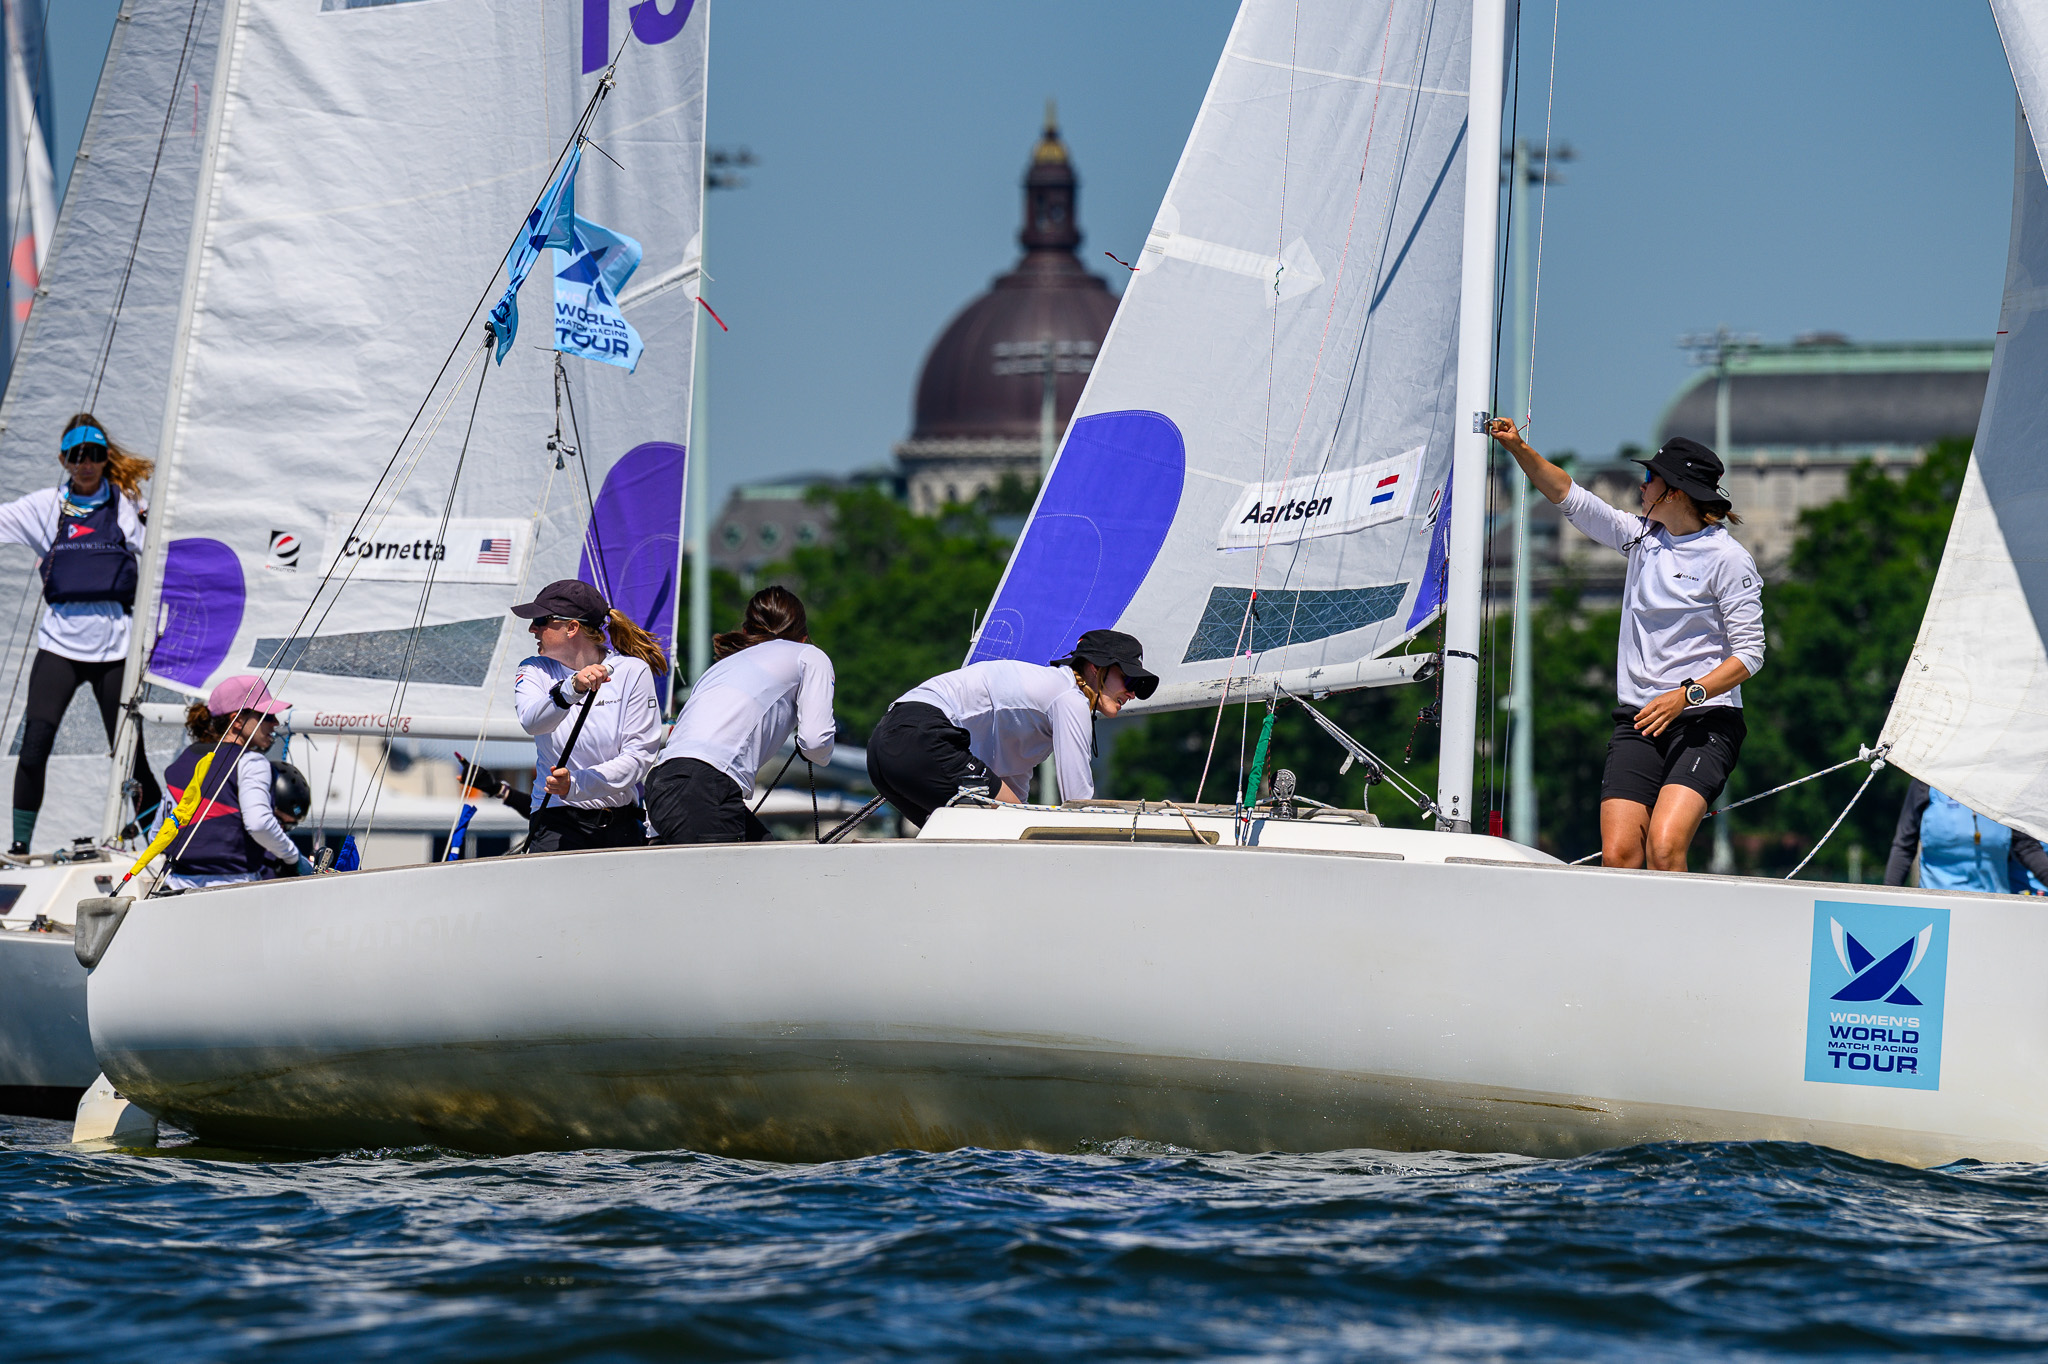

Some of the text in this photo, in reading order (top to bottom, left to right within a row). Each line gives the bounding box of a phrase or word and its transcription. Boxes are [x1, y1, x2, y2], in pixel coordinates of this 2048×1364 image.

[555, 302, 626, 330] WORLD
[555, 318, 629, 339] MATCH RACING
[555, 327, 630, 358] TOUR
[1240, 496, 1333, 524] Aartsen
[342, 536, 446, 561] Cornetta
[313, 712, 412, 733] EastportYCorg
[1829, 1012, 1920, 1028] WOMEN'S
[1828, 1025, 1920, 1044] WORLD
[1827, 1041, 1919, 1054] MATCH RACING
[1827, 1050, 1919, 1075] TOUR
